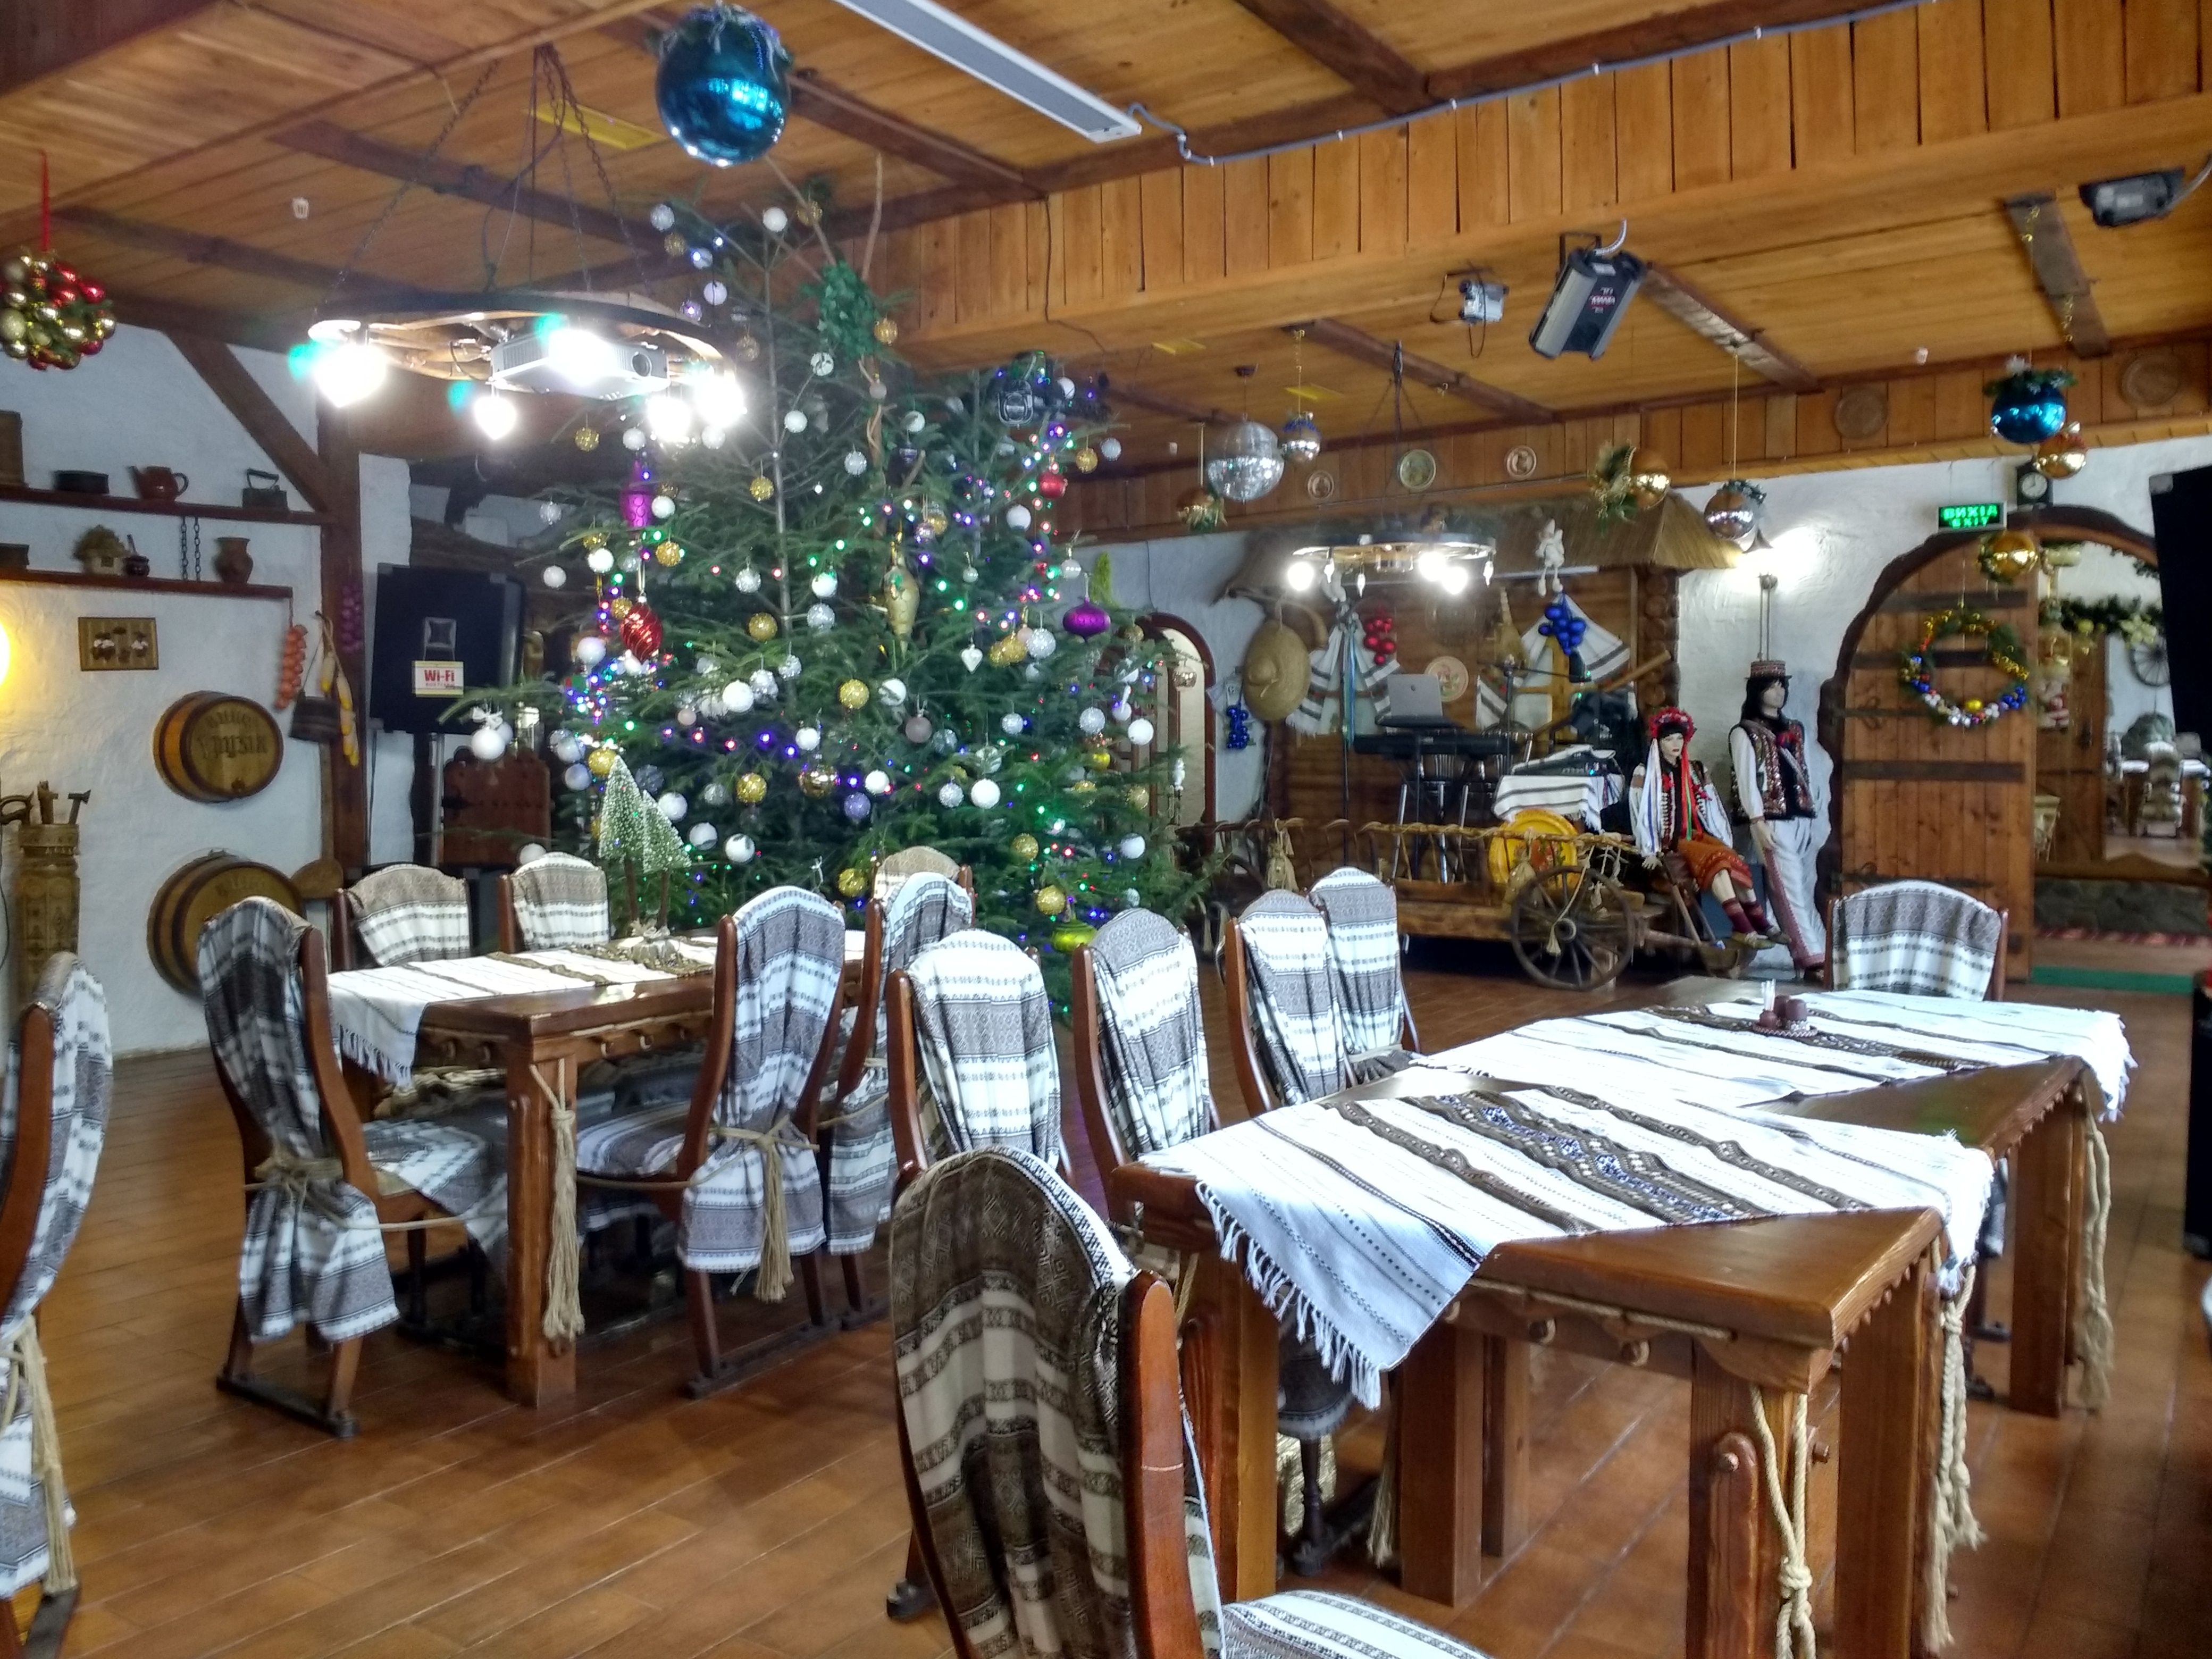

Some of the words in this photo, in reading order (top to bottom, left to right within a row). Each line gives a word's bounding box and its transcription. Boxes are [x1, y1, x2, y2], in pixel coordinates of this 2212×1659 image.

[1942, 505, 1998, 520] ВИХІД
[1951, 516, 1989, 528] EXIT
[424, 669, 455, 682] Wi-Fi
